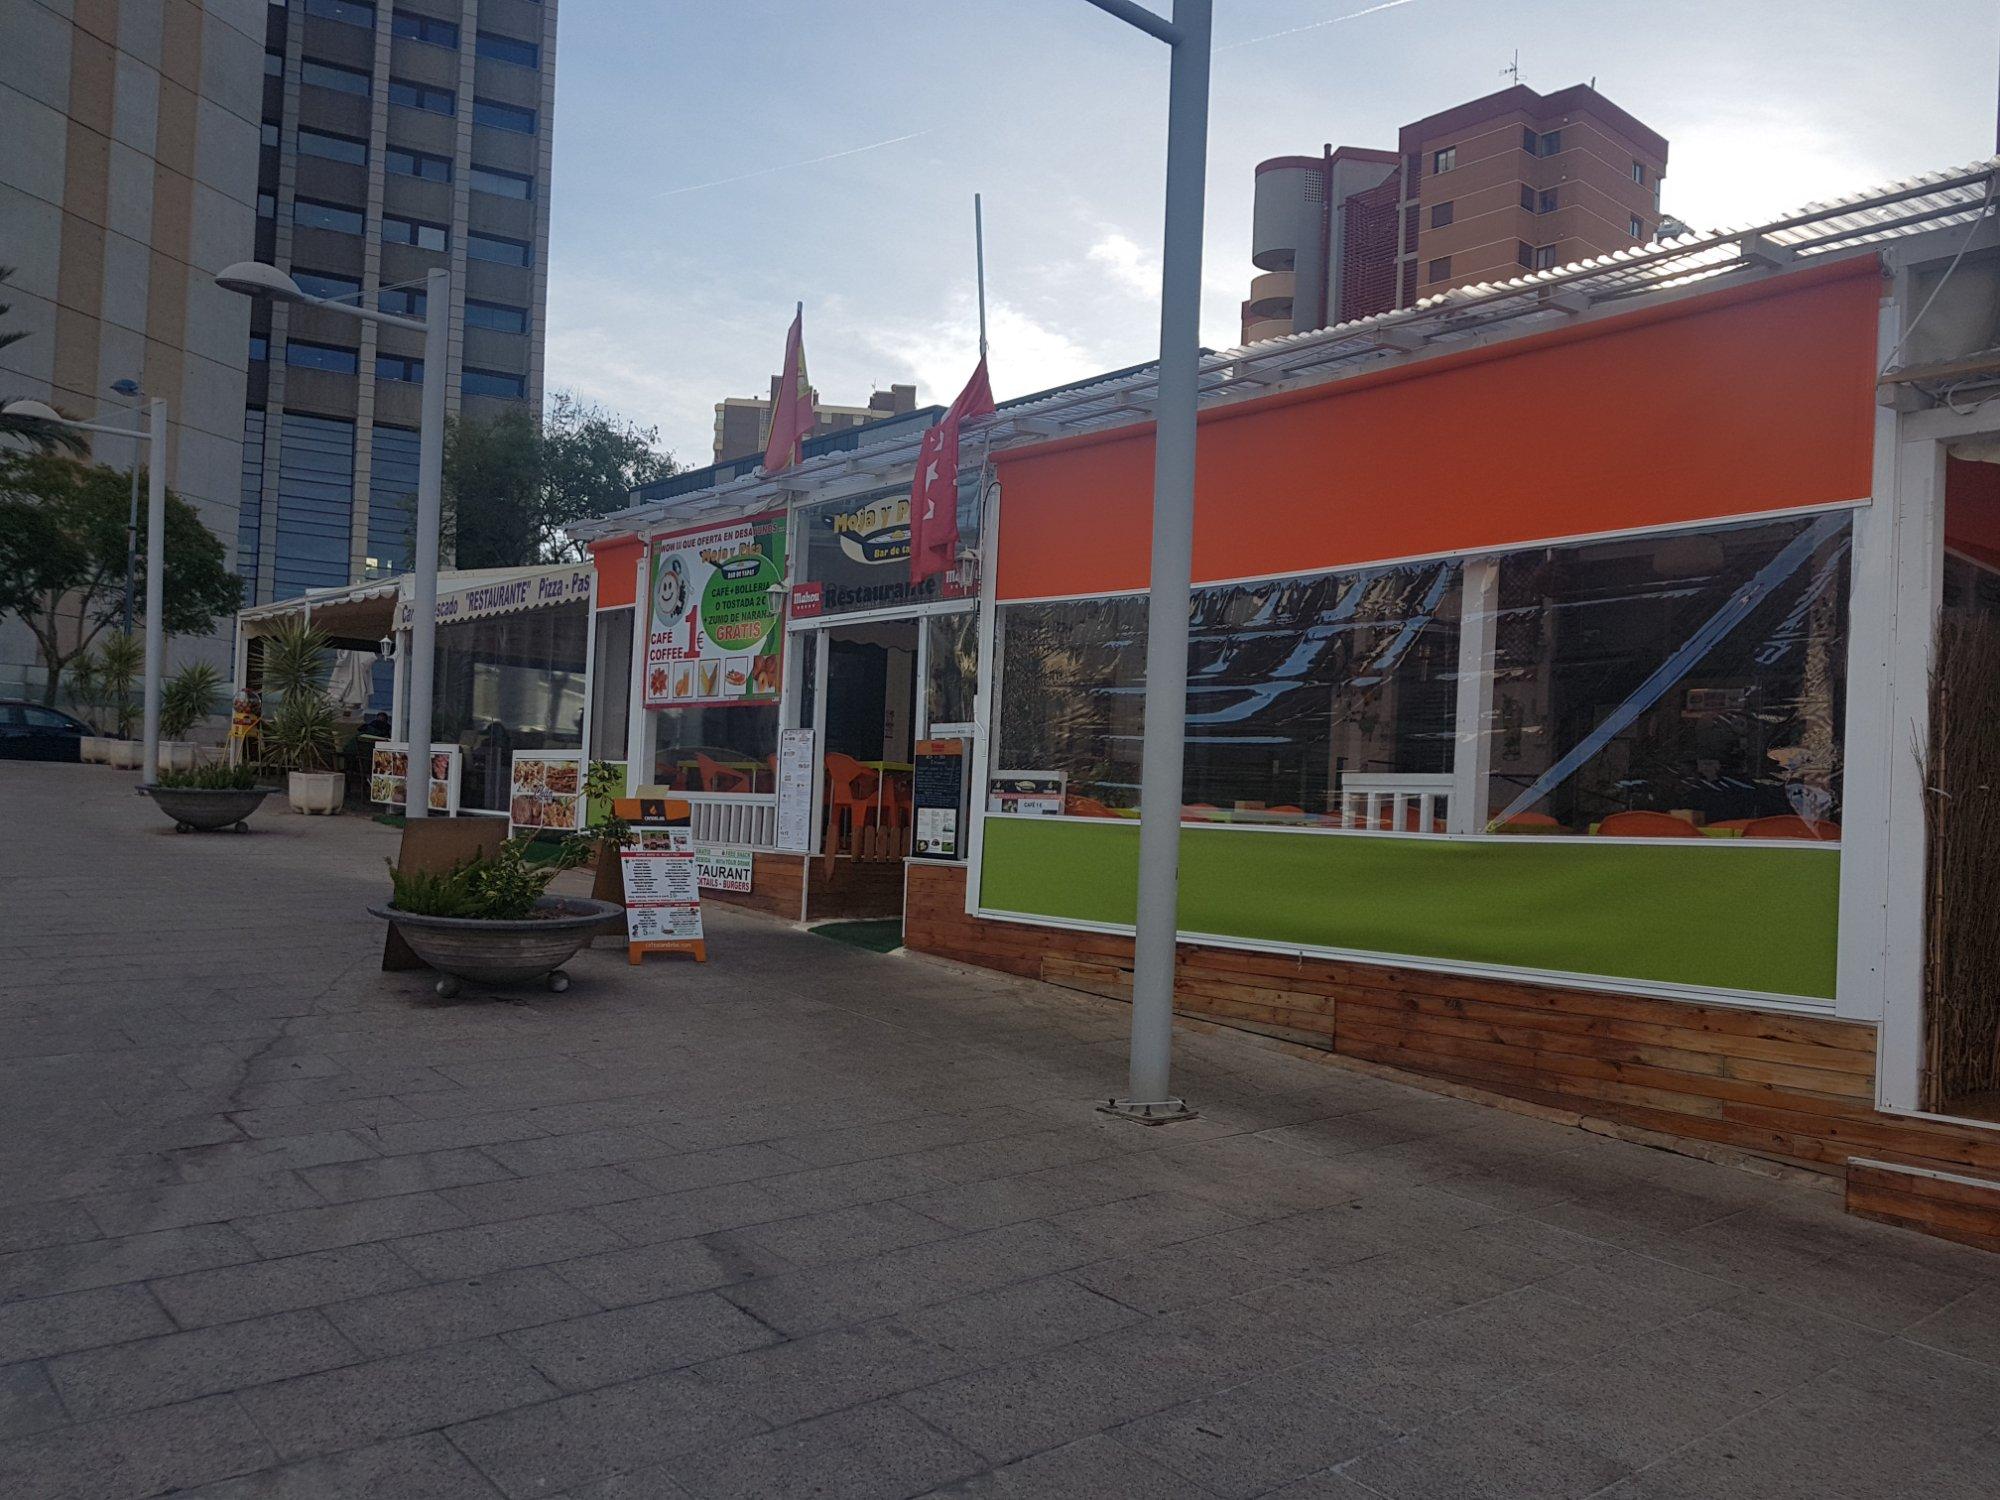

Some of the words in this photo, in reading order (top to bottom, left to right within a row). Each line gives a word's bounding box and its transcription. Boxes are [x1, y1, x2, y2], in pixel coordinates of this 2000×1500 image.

[833, 508, 876, 533] Moja
[897, 499, 911, 522] P
[683, 538, 695, 549] QUE
[697, 532, 722, 545] OFERTA
[724, 530, 734, 541] EN
[874, 548, 887, 559] Bar
[890, 546, 899, 556] de
[902, 545, 911, 555] ta
[402, 604, 415, 624] Car
[538, 576, 563, 600] Pizza
[571, 572, 590, 594] Pas
[722, 596, 755, 610] TOSTADA
[756, 596, 761, 605] 2
[793, 591, 820, 605] Mahou
[708, 614, 729, 624] ZUMO
[730, 613, 740, 622] DE
[650, 628, 673, 645] CAFÉ
[685, 604, 700, 659] 1
[716, 621, 761, 640] GRATIS
[650, 646, 683, 660] COFFEE
[697, 864, 750, 881] TAURANT
[722, 879, 750, 892] BURGERS
